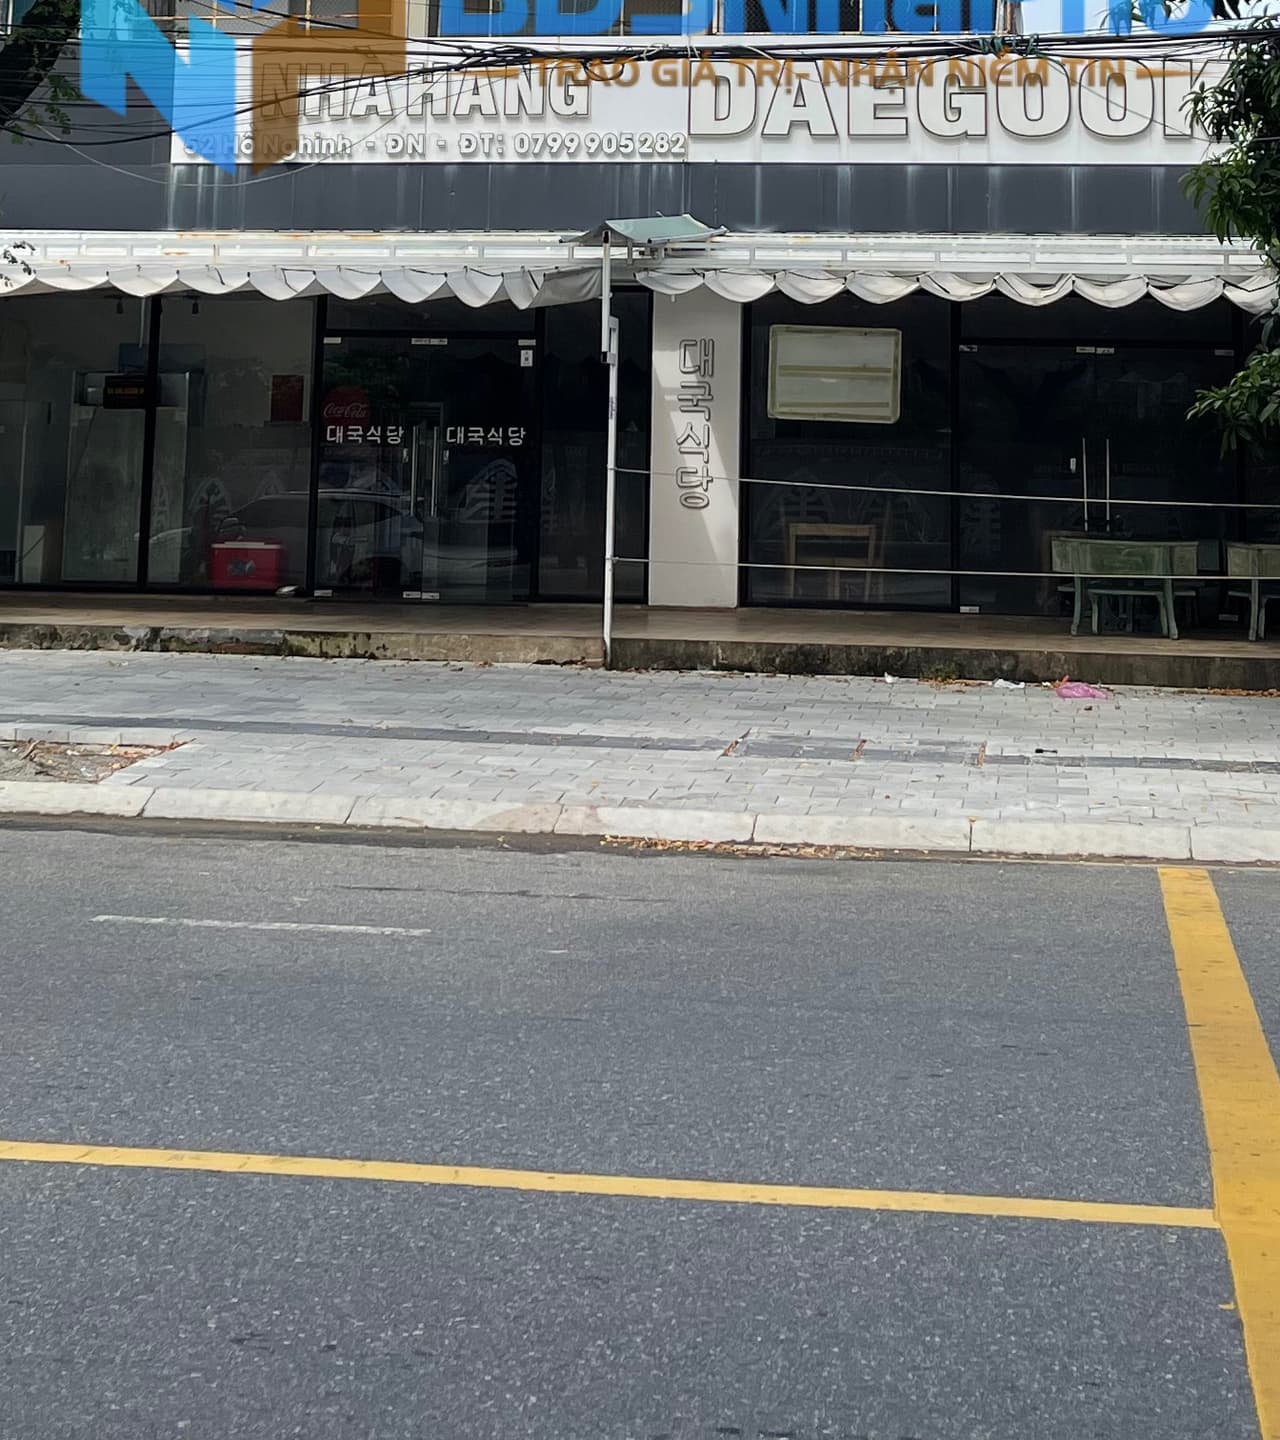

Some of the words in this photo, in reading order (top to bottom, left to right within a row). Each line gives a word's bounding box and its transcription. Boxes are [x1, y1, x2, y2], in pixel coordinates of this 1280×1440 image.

[384, 132, 426, 155] ĐN
[458, 132, 504, 155] ĐT:
[676, 338, 715, 510] 대국식당
[326, 425, 405, 445] 대국식당
[446, 426, 527, 446] 대국식당
